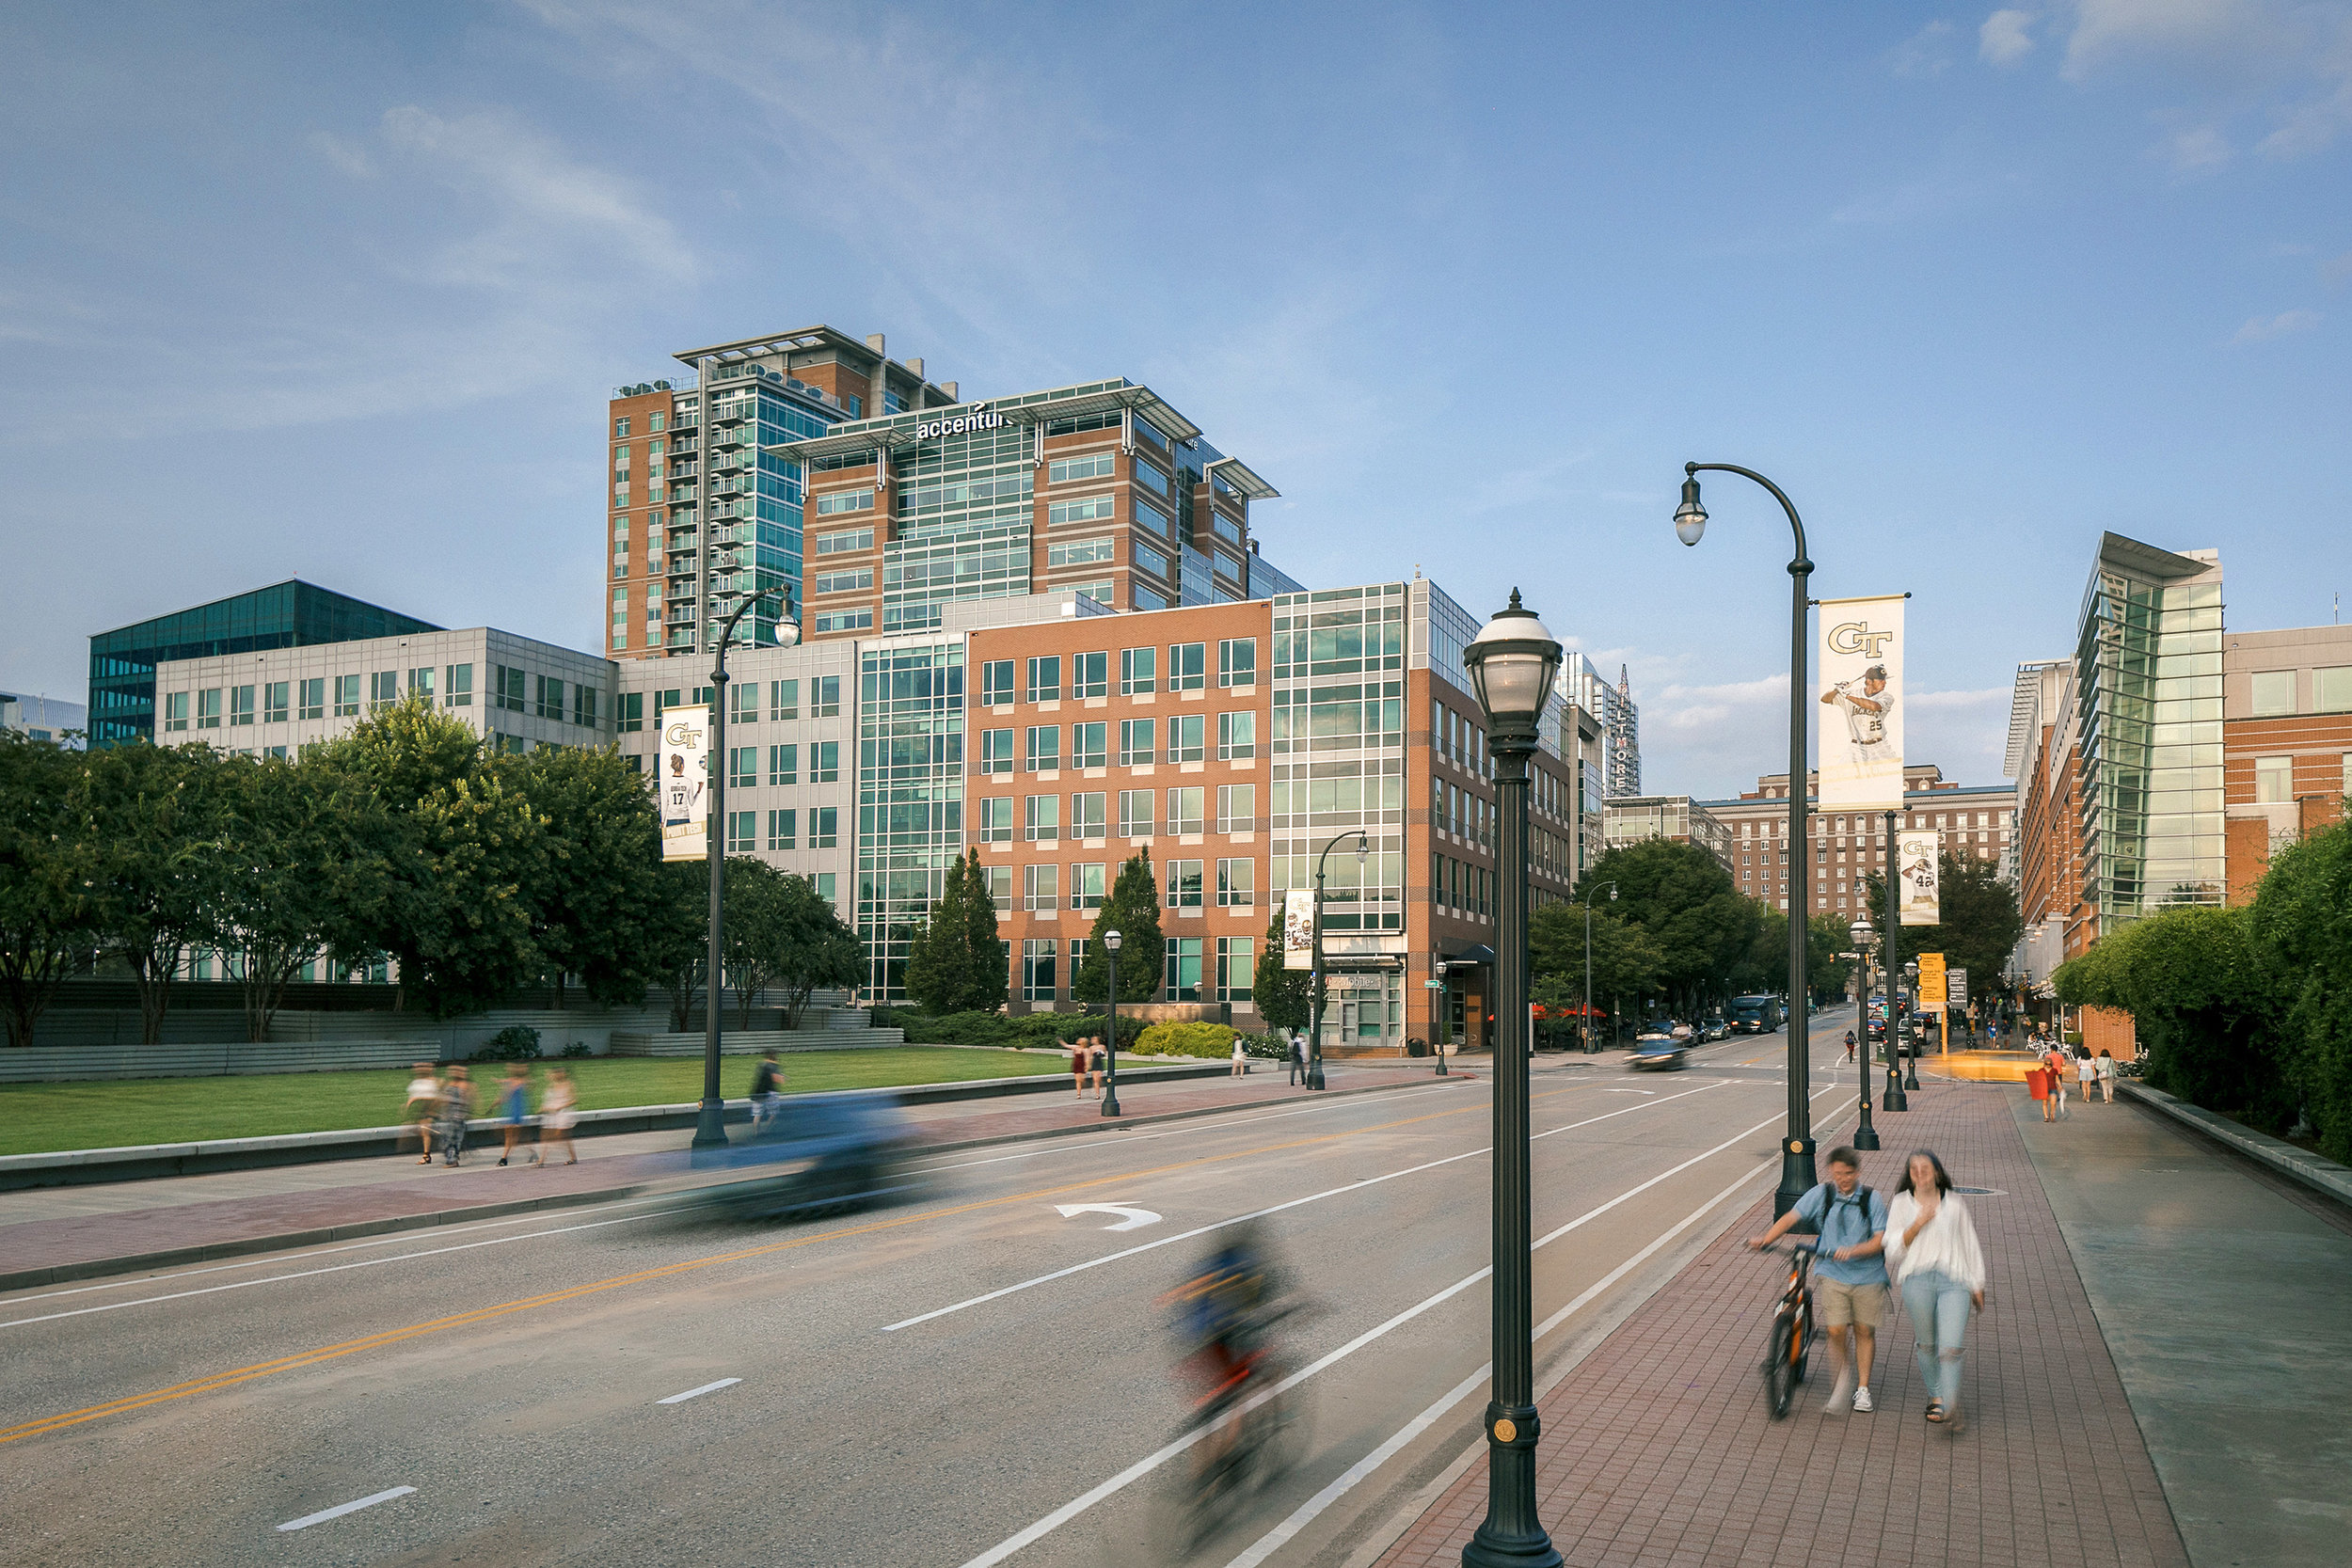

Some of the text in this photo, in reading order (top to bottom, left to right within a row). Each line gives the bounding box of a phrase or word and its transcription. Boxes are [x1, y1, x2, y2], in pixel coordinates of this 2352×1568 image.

[1828, 621, 1893, 658] GT
[1869, 720, 1882, 732] 25
[666, 722, 702, 749] GT
[1615, 682, 1628, 788] BILTMORE
[673, 793, 684, 805] 17
[1903, 840, 1933, 857] GT
[1915, 875, 1931, 887] 42
[1288, 897, 1311, 912] GT
